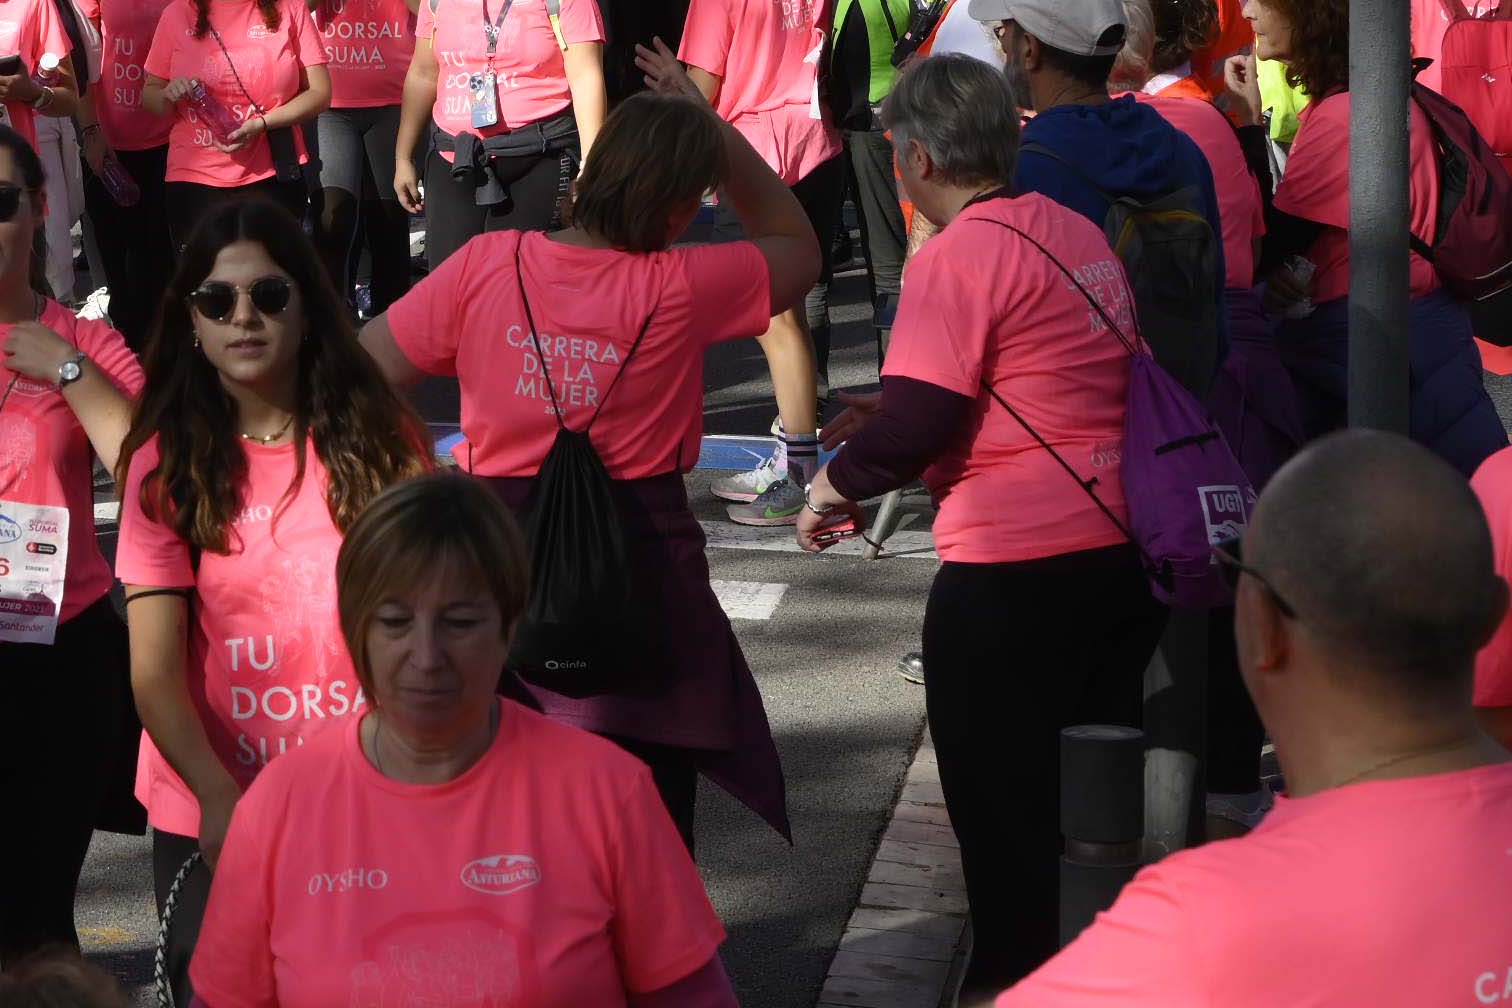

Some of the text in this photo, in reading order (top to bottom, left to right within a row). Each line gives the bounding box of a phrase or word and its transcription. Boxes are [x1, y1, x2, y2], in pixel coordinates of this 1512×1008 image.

[324, 21, 403, 40] DORSAL
[325, 45, 384, 64] SUMA
[441, 50, 466, 67] TU
[505, 324, 621, 365] CARRERA
[522, 351, 596, 384] DE LA
[514, 374, 599, 408] MUJER
[1090, 452, 1121, 469] OYS
[28, 524, 60, 535] SUMA
[0, 618, 45, 634] Santander
[225, 634, 276, 672] TU
[308, 868, 389, 897] OYSHO
[468, 866, 538, 887] ASTURIANA
